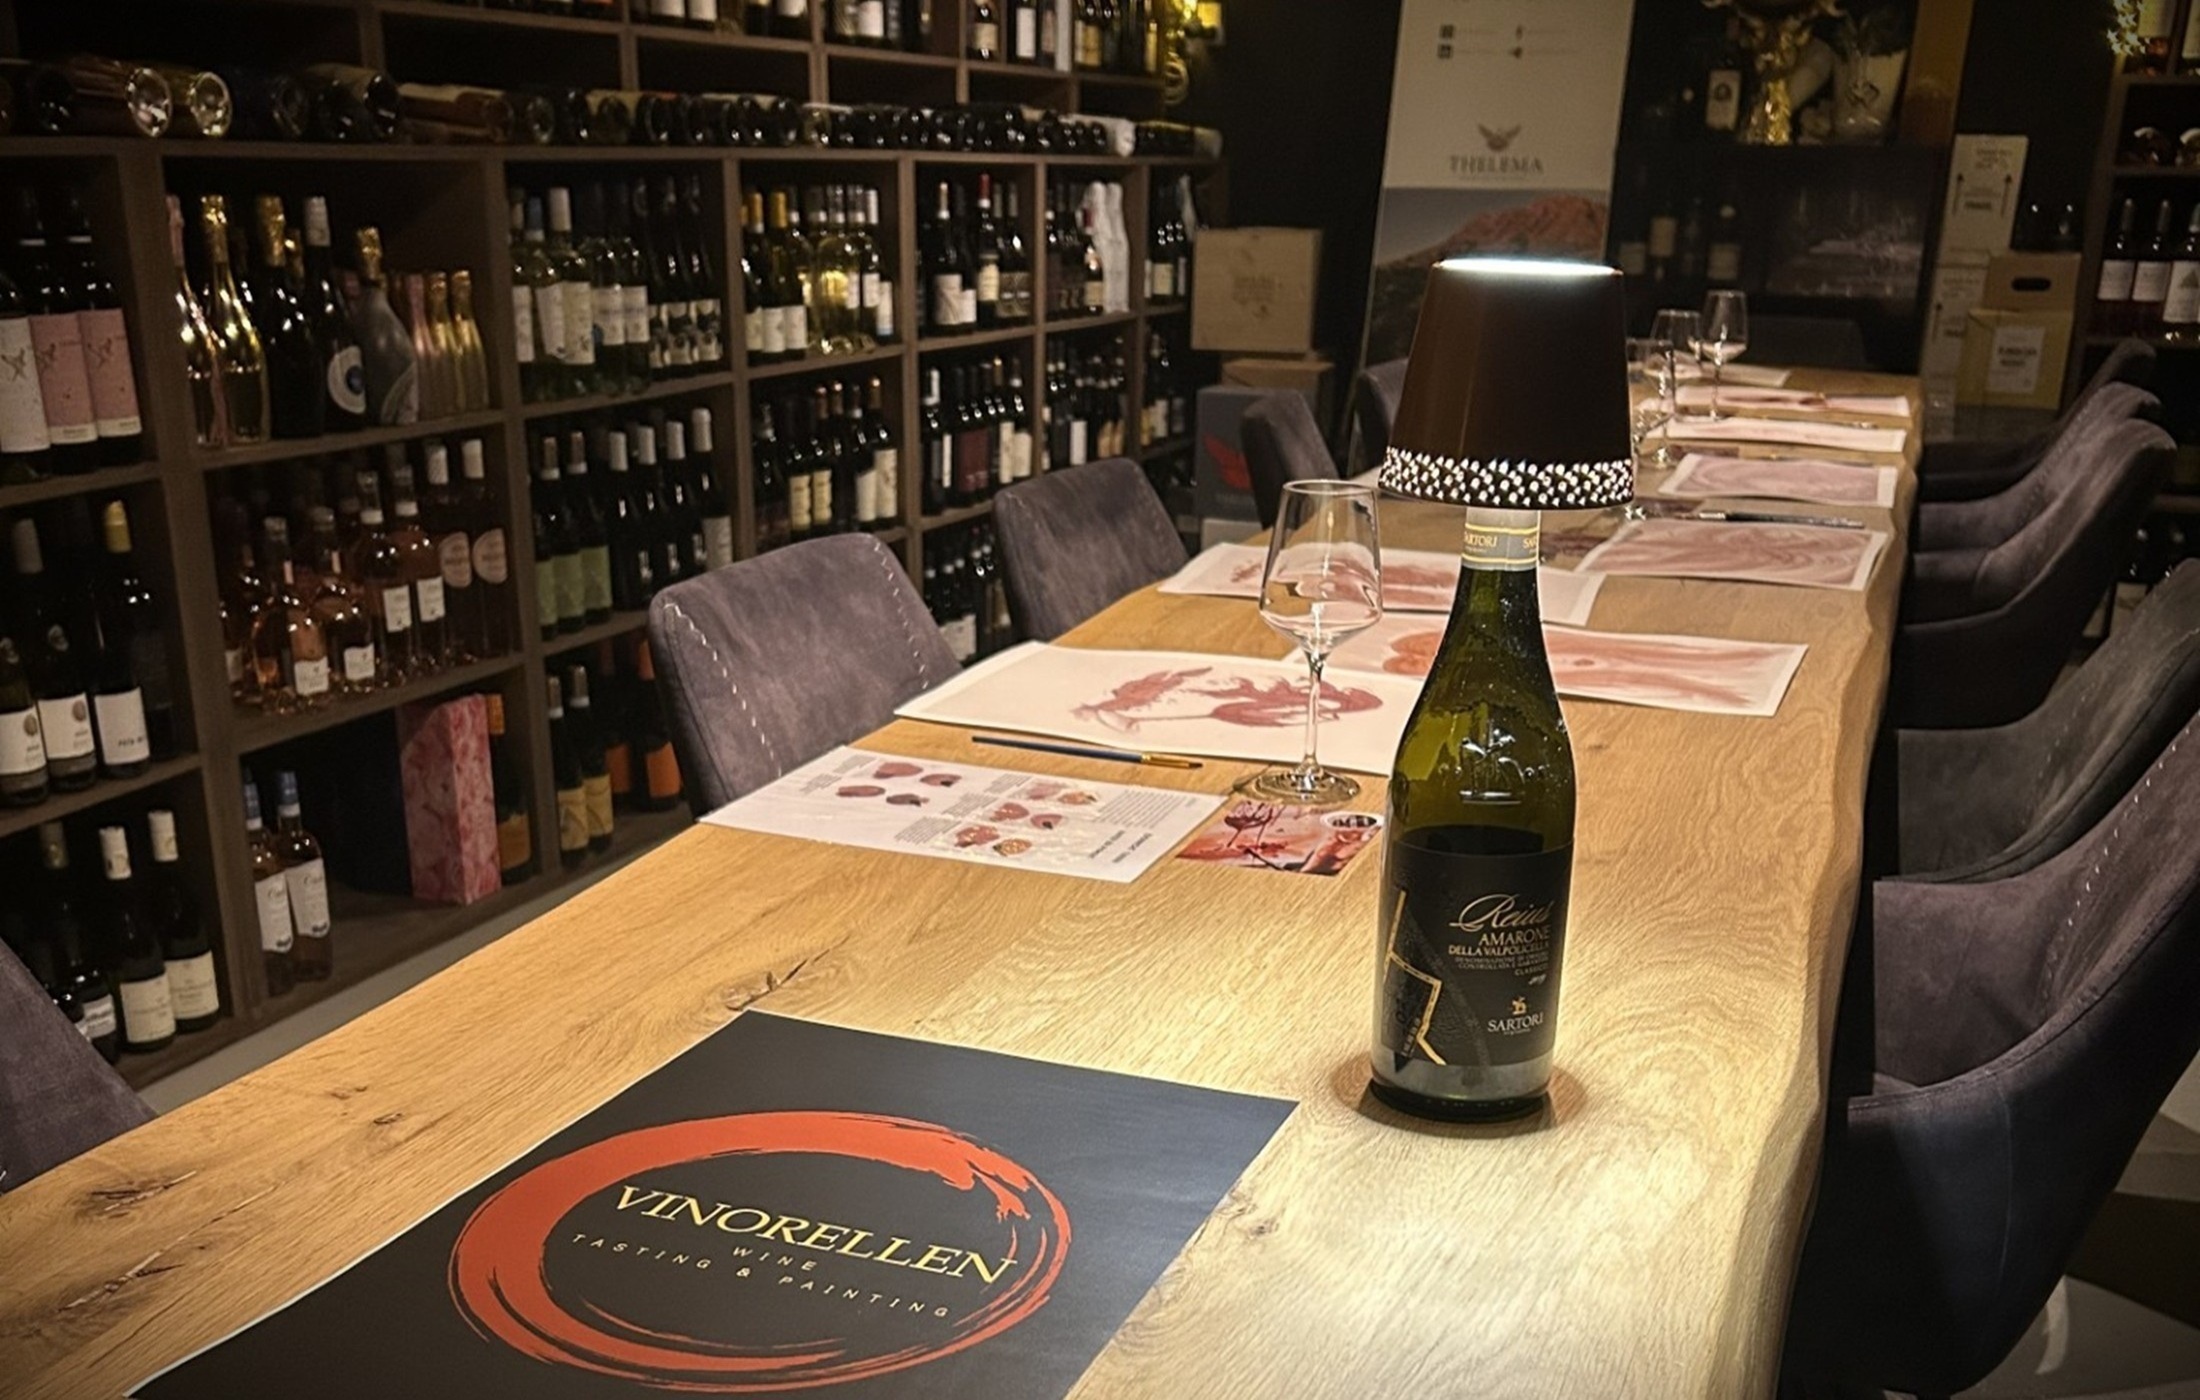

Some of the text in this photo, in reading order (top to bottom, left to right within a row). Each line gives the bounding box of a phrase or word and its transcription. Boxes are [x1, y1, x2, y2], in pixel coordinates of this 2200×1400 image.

[1450, 154, 1544, 174] THELEMA
[1449, 893, 1554, 932] Reius
[1479, 926, 1549, 946] AMARONE
[1448, 945, 1482, 956] DELLA
[1483, 941, 1549, 956] VALPOLICELLA
[1487, 1011, 1544, 1033] SARTORI
[614, 1184, 1018, 1285] VINORELLEN
[732, 1246, 817, 1271] WINE
[572, 1233, 950, 1319] TASTING & PAINTING
